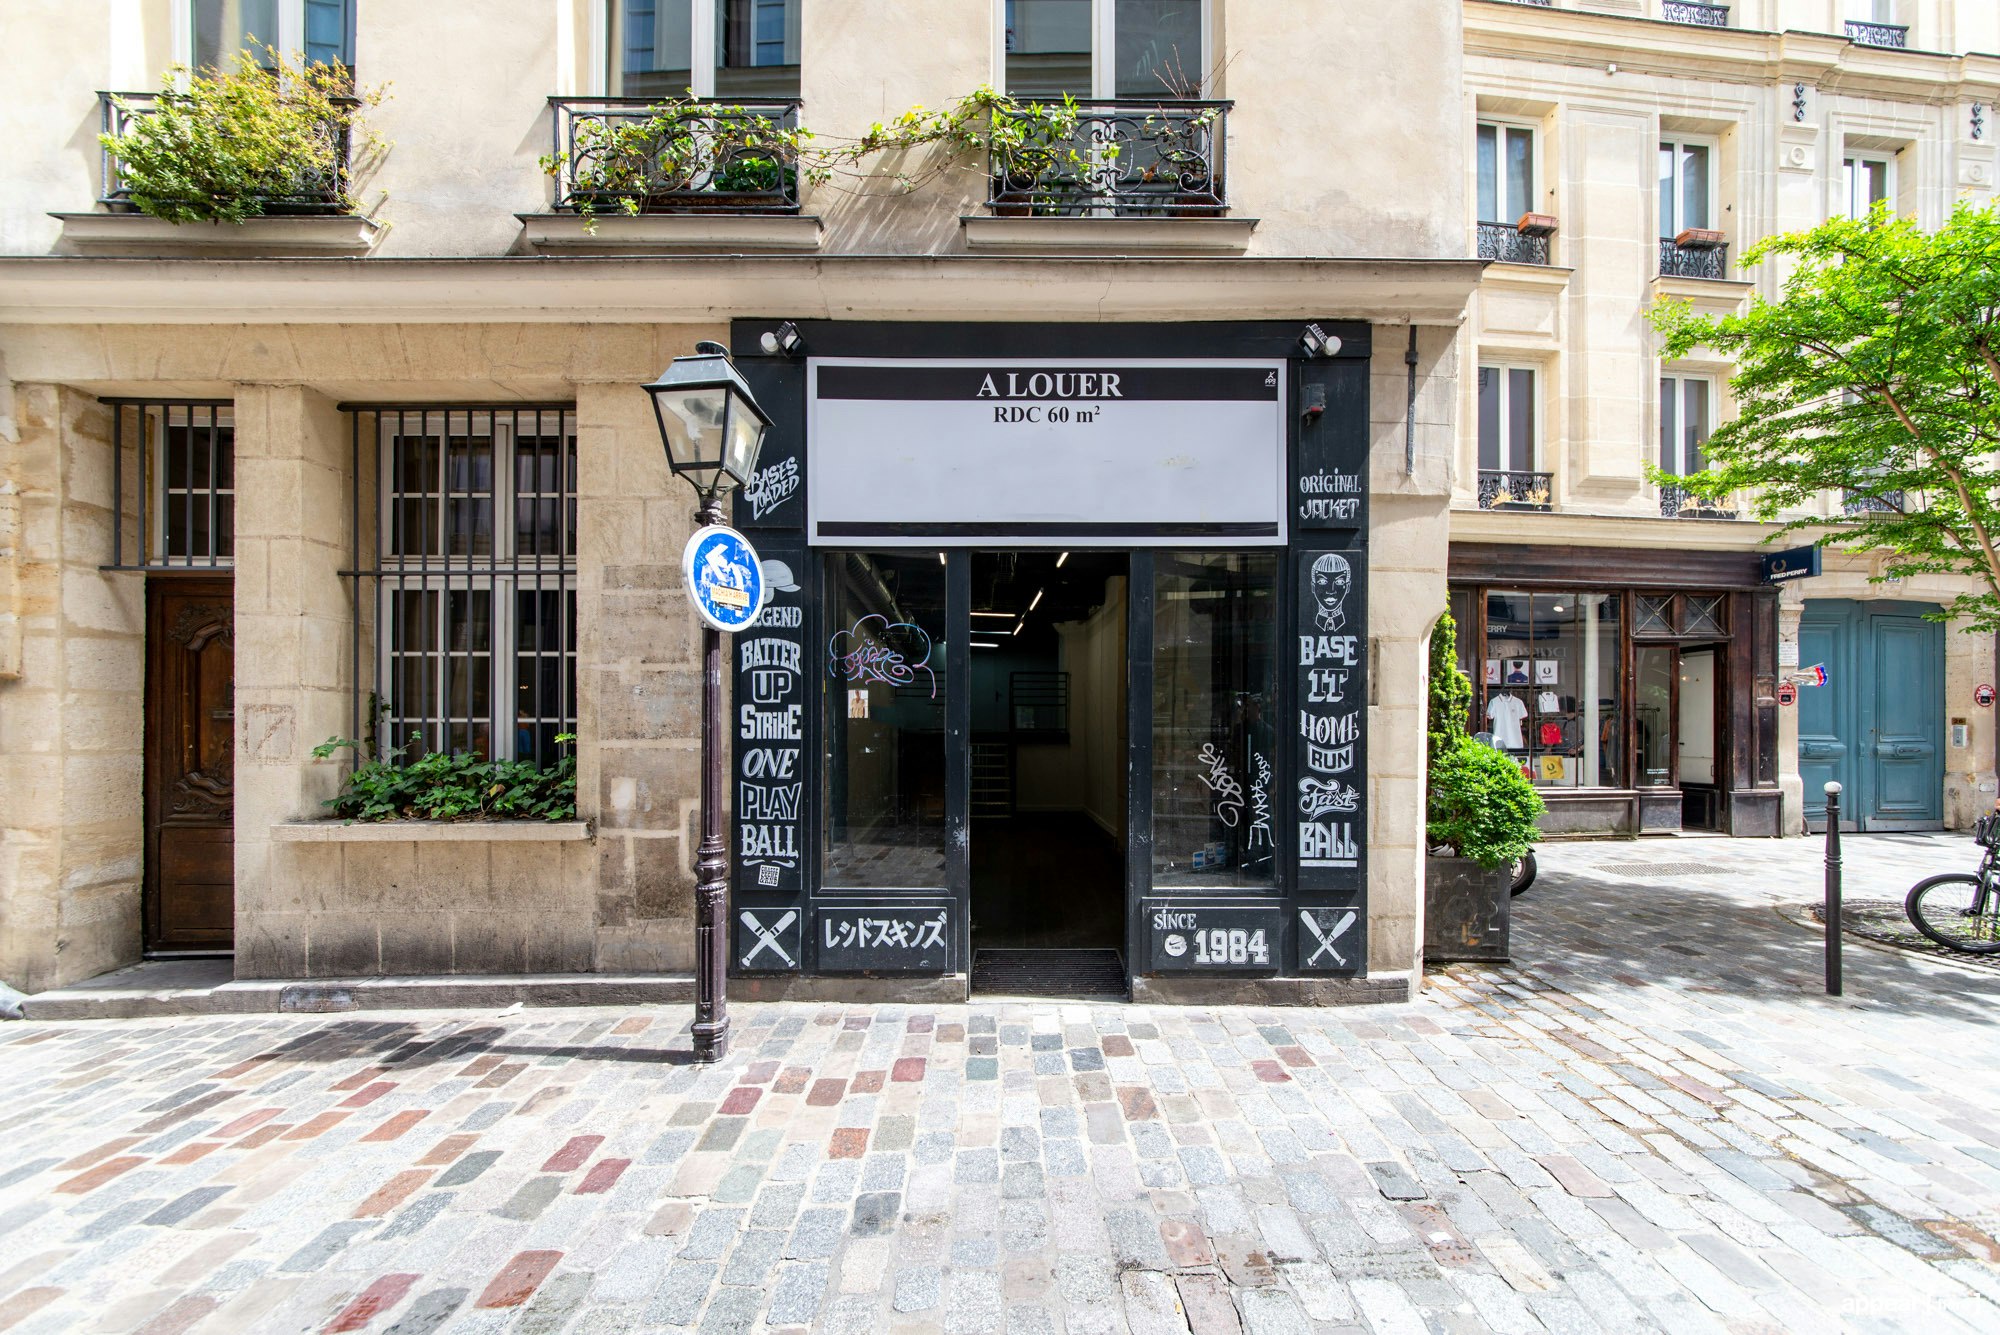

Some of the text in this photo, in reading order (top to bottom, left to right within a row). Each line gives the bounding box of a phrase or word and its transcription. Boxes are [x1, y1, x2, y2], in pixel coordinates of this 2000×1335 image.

[976, 372, 1123, 398] A LOUER
[993, 406, 1041, 423] RDC
[1047, 406, 1070, 423] 60
[750, 456, 798, 494] BASES
[744, 474, 801, 521] LOADED
[1299, 498, 1360, 520] JACKET
[1770, 568, 1808, 580] FRED PERRY
[751, 606, 803, 628] EGEND
[741, 638, 801, 674] BATTER
[1299, 635, 1359, 666] BASE
[752, 670, 792, 703] UP
[1308, 668, 1349, 703] IT
[1300, 710, 1360, 745] HOME
[742, 748, 800, 779] ONE
[1311, 747, 1350, 770] RUN
[741, 781, 802, 820] PLAY
[1299, 776, 1360, 821] Fast
[741, 825, 799, 858] BALL
[1299, 822, 1358, 858] BALL
[1193, 928, 1270, 965] 1984
